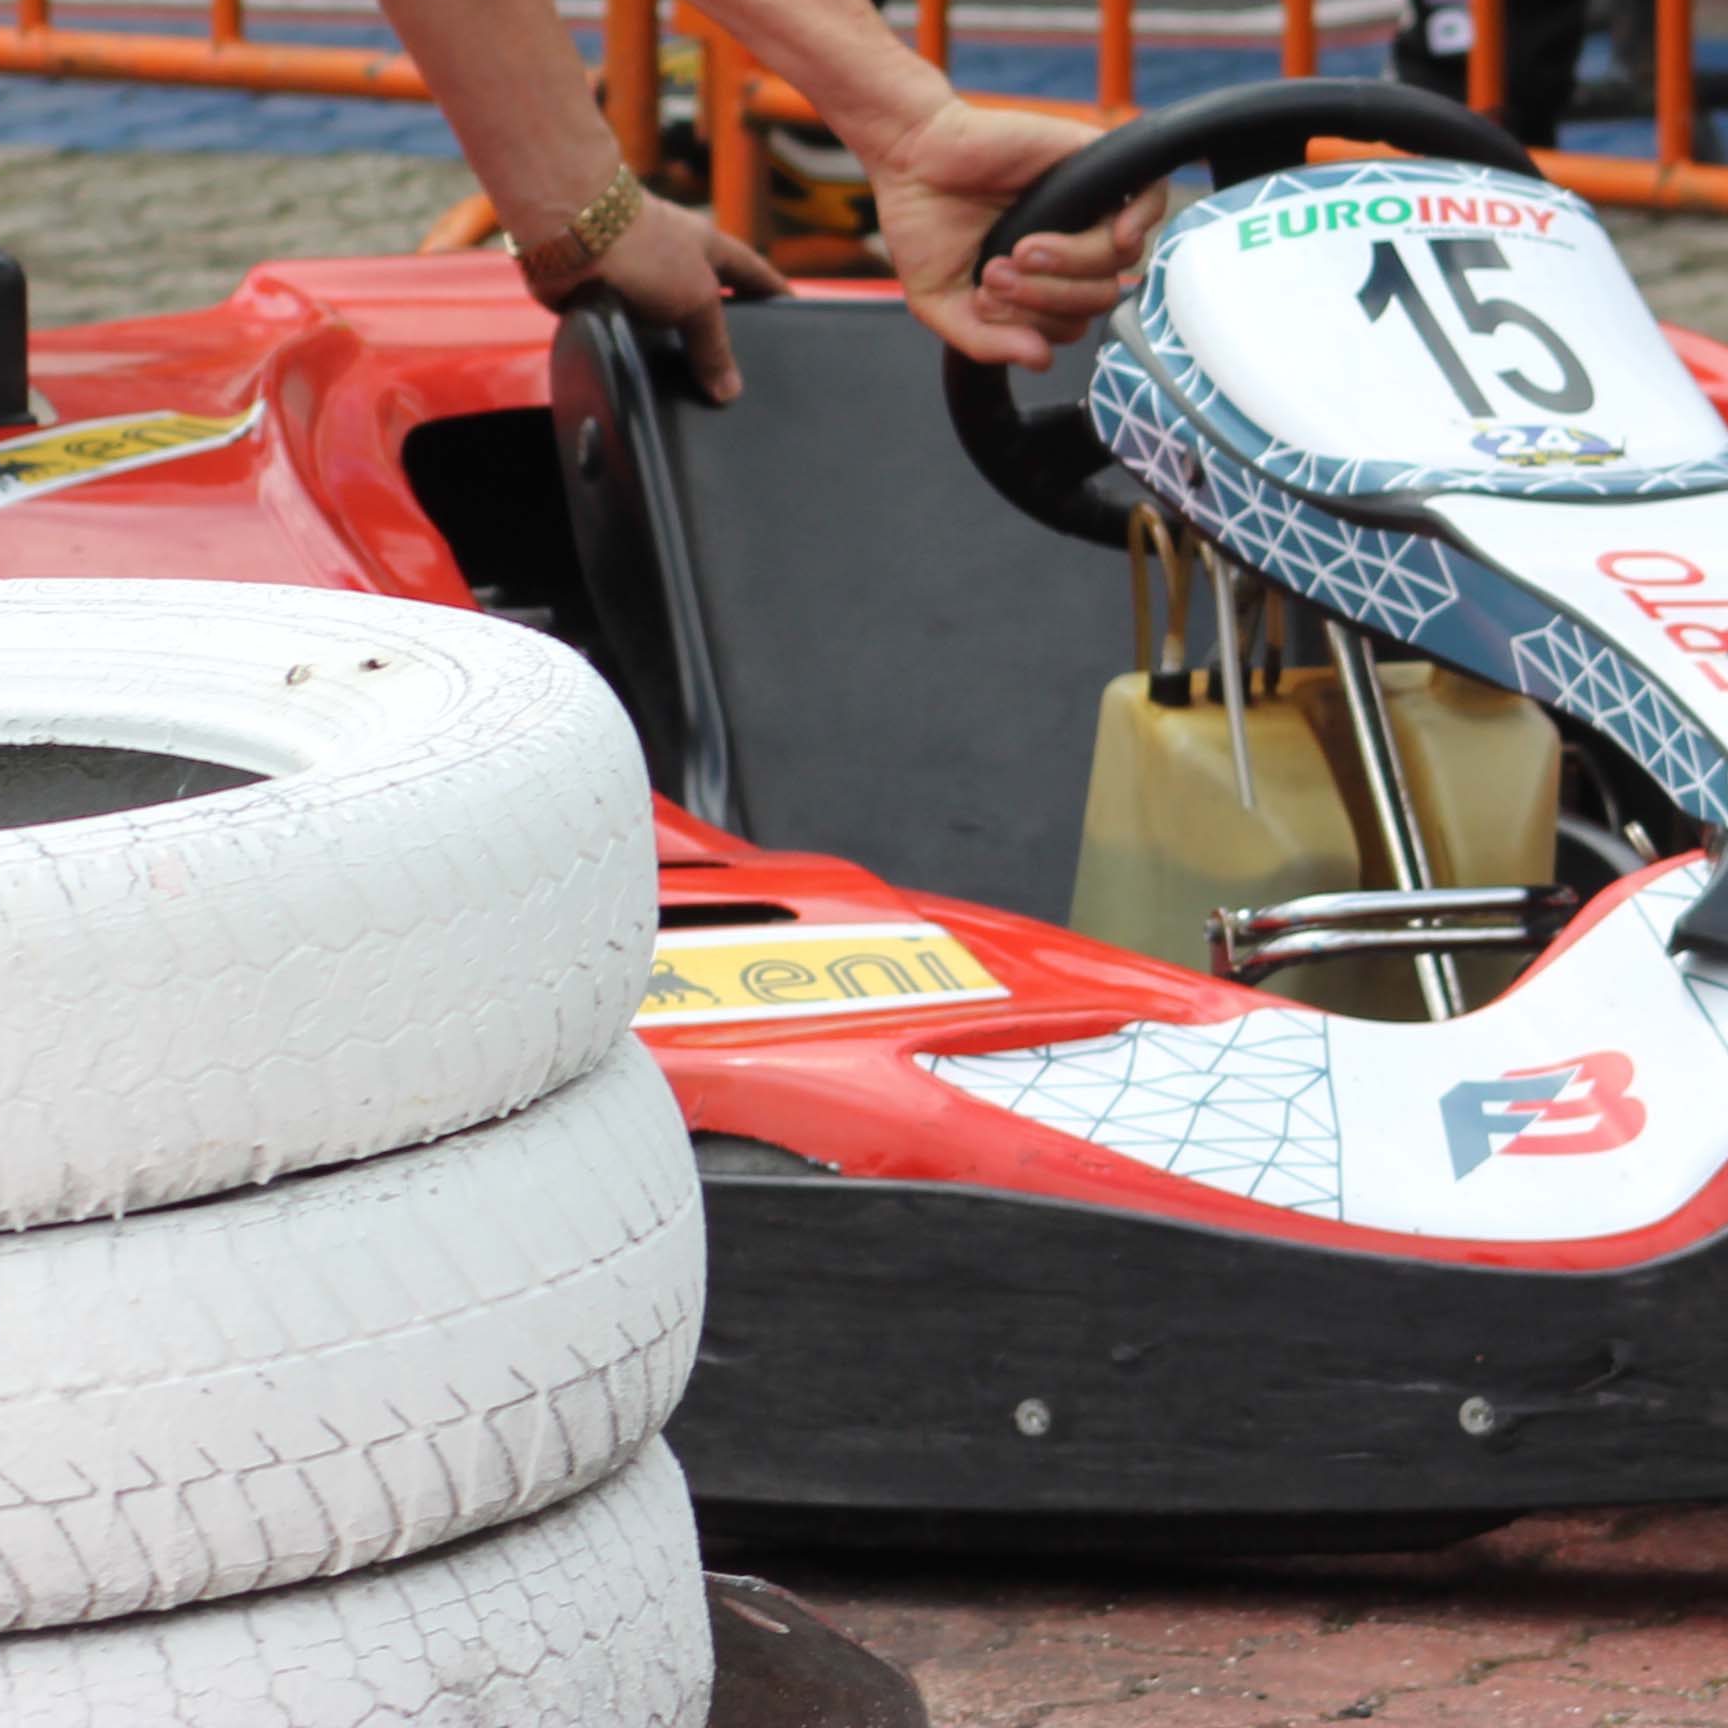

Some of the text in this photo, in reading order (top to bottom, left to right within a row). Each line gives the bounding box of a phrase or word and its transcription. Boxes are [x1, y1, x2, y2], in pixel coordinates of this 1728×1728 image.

[1238, 195, 1556, 252] EUROINDY
[1356, 236, 1595, 419] 15
[739, 935, 964, 1005] eni
